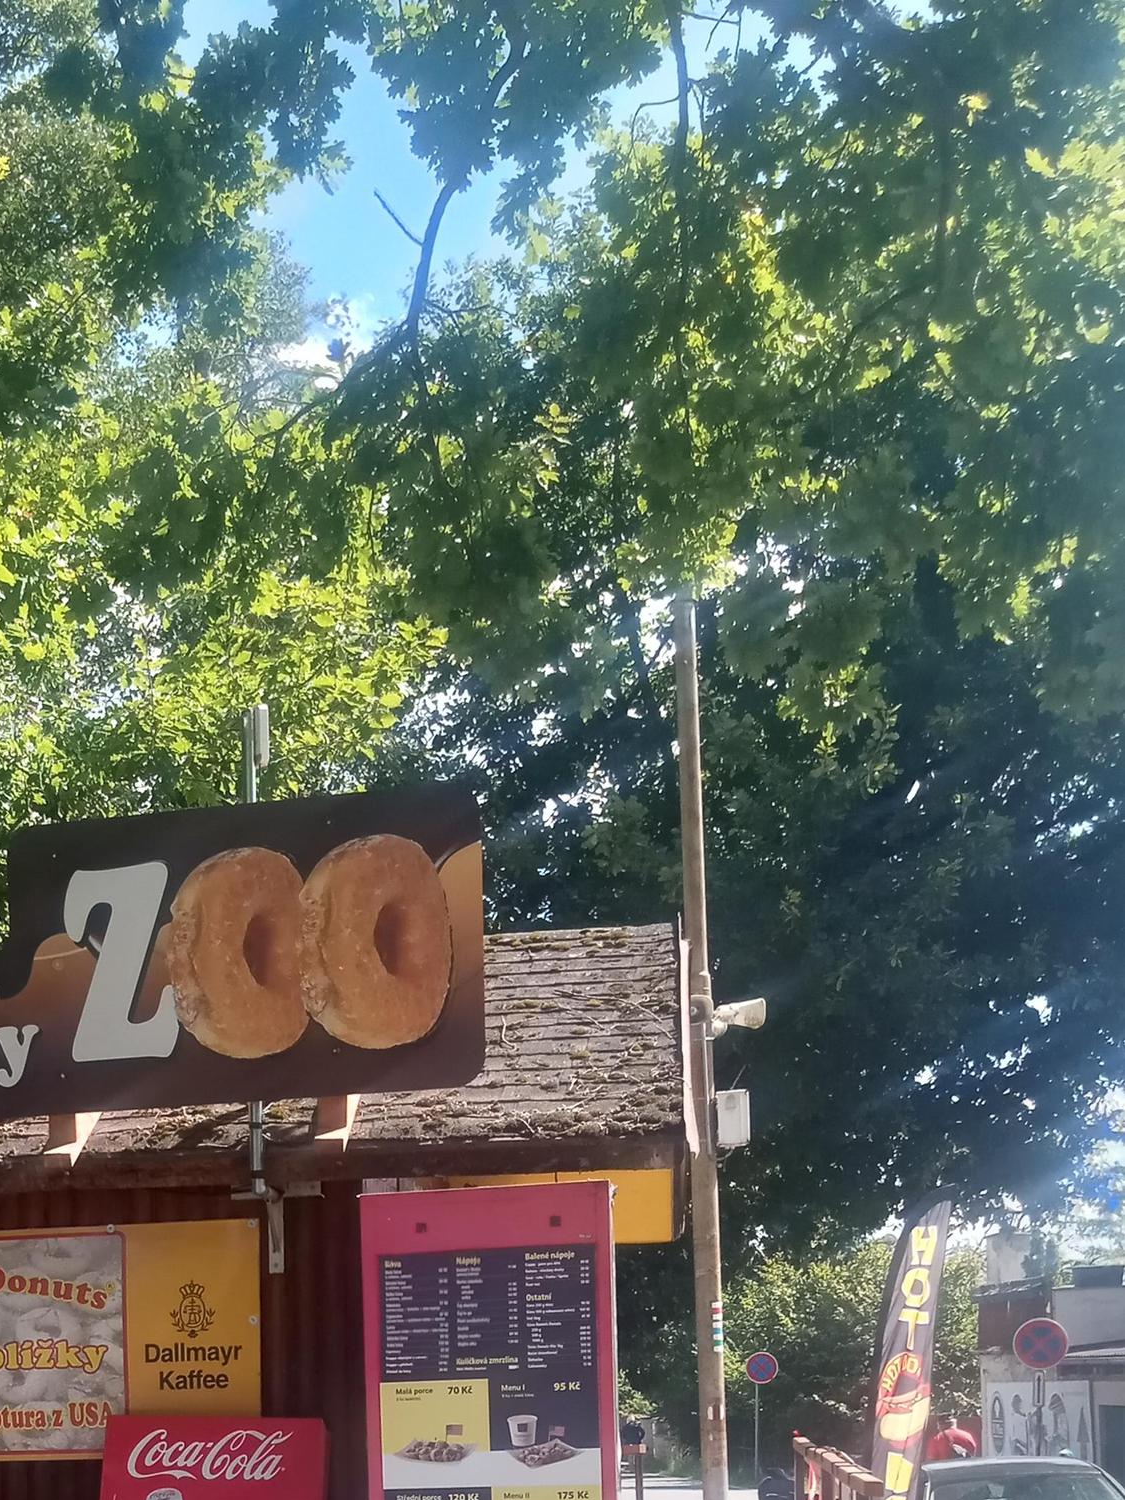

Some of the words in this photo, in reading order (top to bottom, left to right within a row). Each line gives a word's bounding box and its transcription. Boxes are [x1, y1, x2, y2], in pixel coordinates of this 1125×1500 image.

[63, 833, 452, 1063] ZOO
[898, 1225, 938, 1350] HOT
[144, 1342, 242, 1366] Dallmayr
[159, 1370, 229, 1390] Kaffee
[447, 1386, 460, 1395] 70
[461, 1385, 473, 1394] Kč
[500, 1384, 521, 1392] Menu
[553, 1382, 567, 1391] 95
[568, 1381, 581, 1391] Kč
[52, 1409, 63, 1427] z
[68, 1401, 113, 1427] USA
[127, 1429, 293, 1481] Coca-Cola
[467, 1492, 480, 1500] Kč
[557, 1491, 574, 1500] 175
[577, 1490, 589, 1499] Kč
